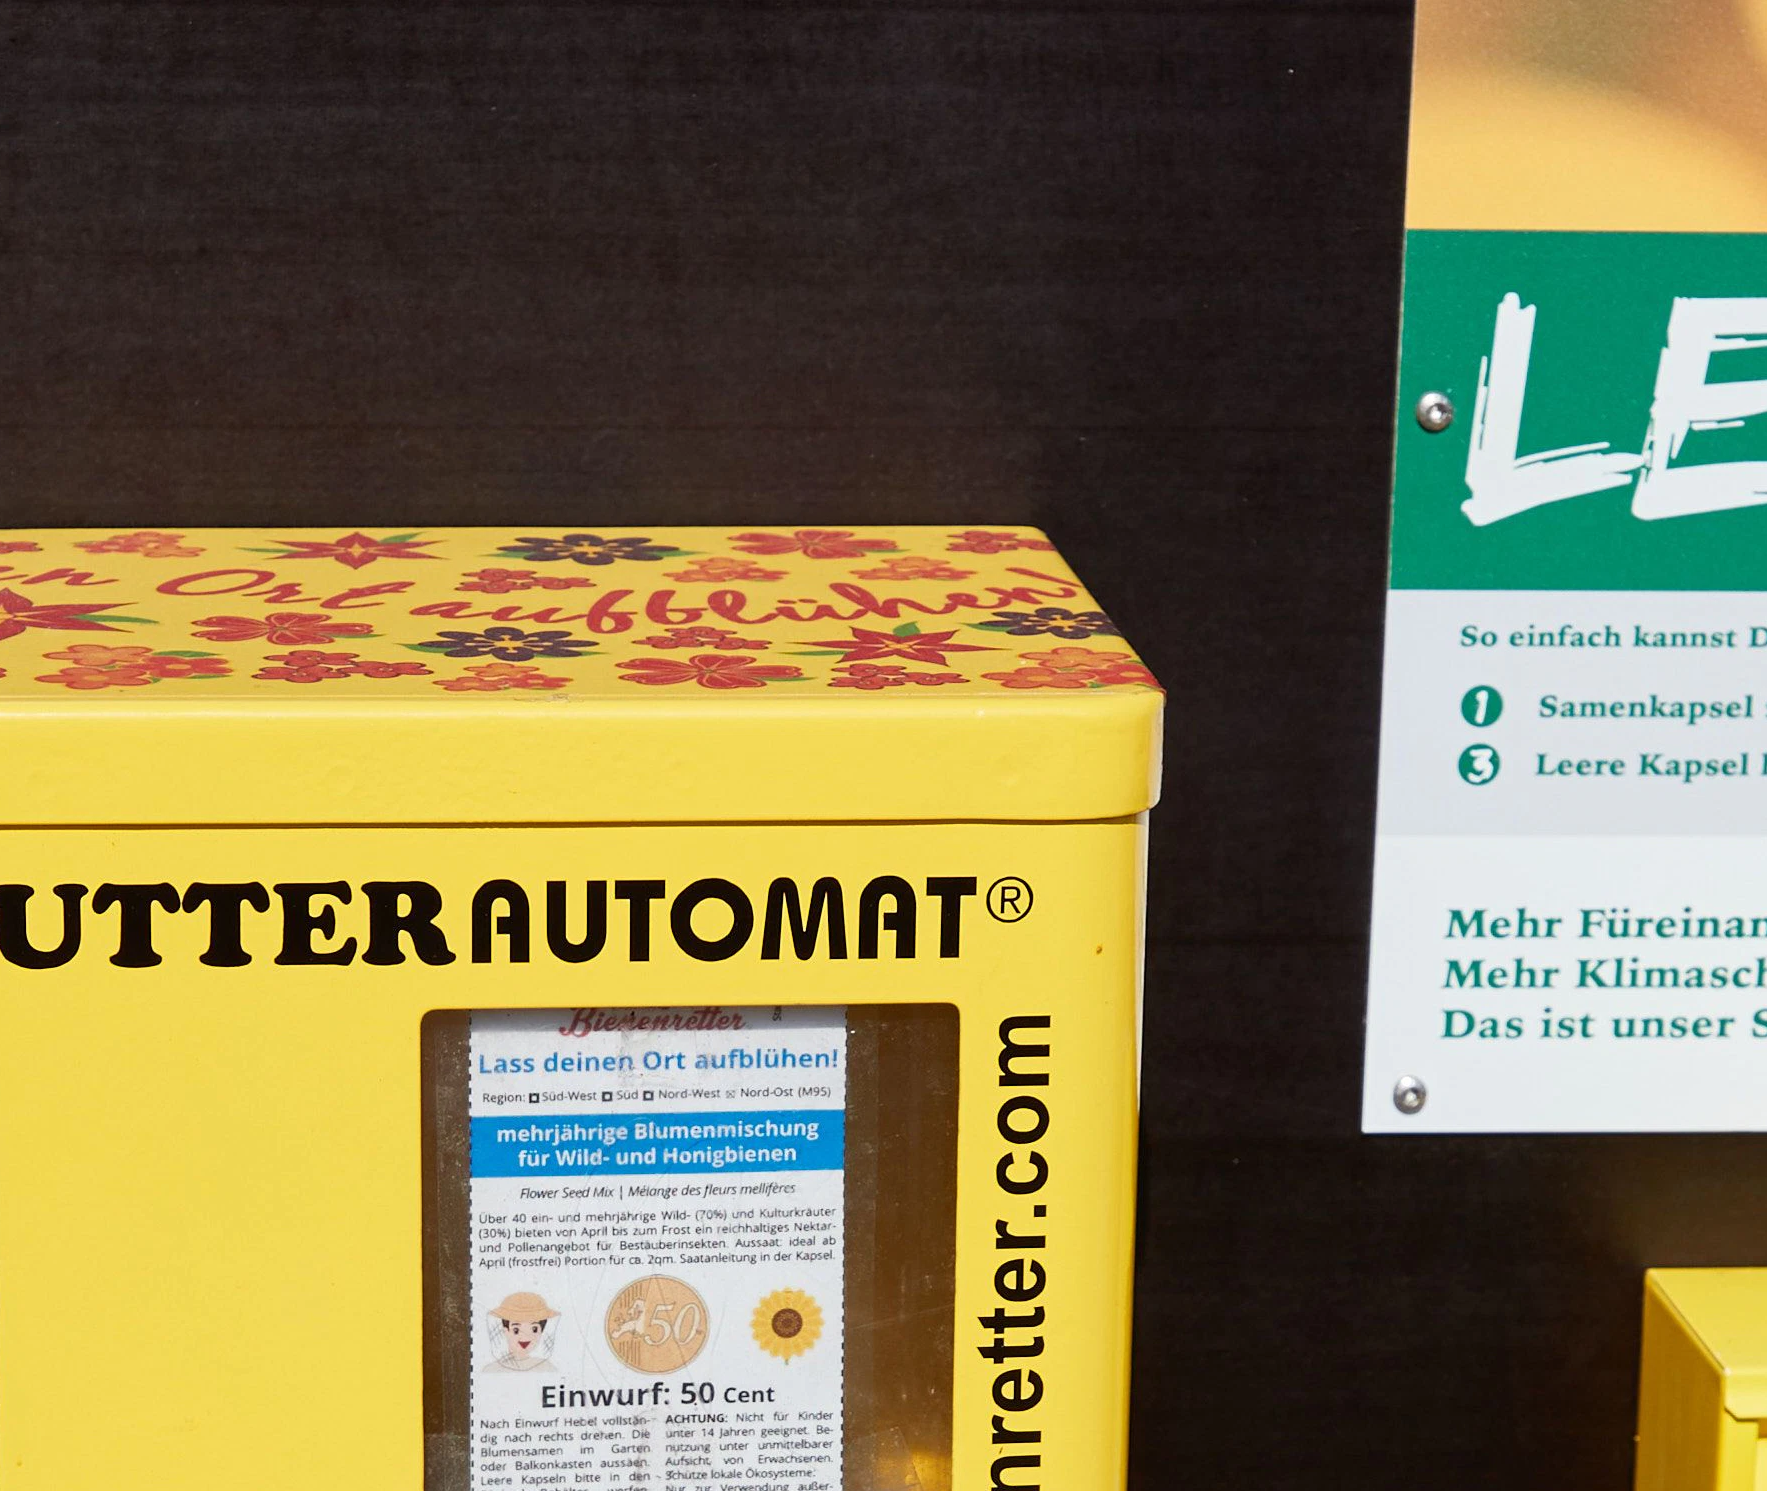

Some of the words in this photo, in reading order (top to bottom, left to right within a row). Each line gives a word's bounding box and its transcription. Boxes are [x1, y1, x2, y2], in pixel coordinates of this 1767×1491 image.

[154, 568, 417, 611] Ort
[410, 567, 1087, 634] aufblühen!
[1460, 625, 1498, 647] So
[1509, 624, 1621, 648] einfach
[1633, 625, 1736, 648] kannst
[1539, 694, 1753, 726] Samenkapsel
[1536, 753, 1626, 776] Leere
[1639, 752, 1748, 784] Kapsel
[1446, 907, 1563, 939] Mehr
[1444, 957, 1560, 989] Mehr
[1442, 1009, 1523, 1039] Das
[1541, 1007, 1593, 1039] ist
[1612, 1017, 1735, 1038] unser
[479, 1054, 535, 1074] Lass
[543, 1051, 636, 1073] deinen
[642, 1050, 686, 1071] Ort
[694, 1047, 838, 1070] aufblühen!
[482, 1092, 526, 1106] Region:
[541, 1091, 597, 1102] Süd-West
[615, 1089, 639, 1101] Süd
[658, 1088, 721, 1100] Nord-West
[740, 1086, 794, 1098] Nord-Ost
[797, 1086, 832, 1099] (M95)
[497, 1123, 629, 1143] mehrjährige
[634, 1119, 820, 1141] Blumenmischung
[518, 1149, 551, 1168] für
[554, 1148, 610, 1167] Wild-
[615, 1146, 657, 1166] und
[663, 1145, 797, 1169] Honigbienen
[519, 1187, 555, 1199] Flower
[561, 1186, 591, 1199] Seed
[592, 1186, 615, 1198] Mix
[627, 1184, 679, 1200] Mélange
[680, 1184, 702, 1196] des
[702, 1183, 738, 1199] fleurs
[739, 1181, 796, 1197] mellifères
[644, 1302, 701, 1346] 50
[541, 1383, 671, 1409] Einwurf:
[681, 1382, 716, 1405] 50
[724, 1386, 775, 1404] Cent
